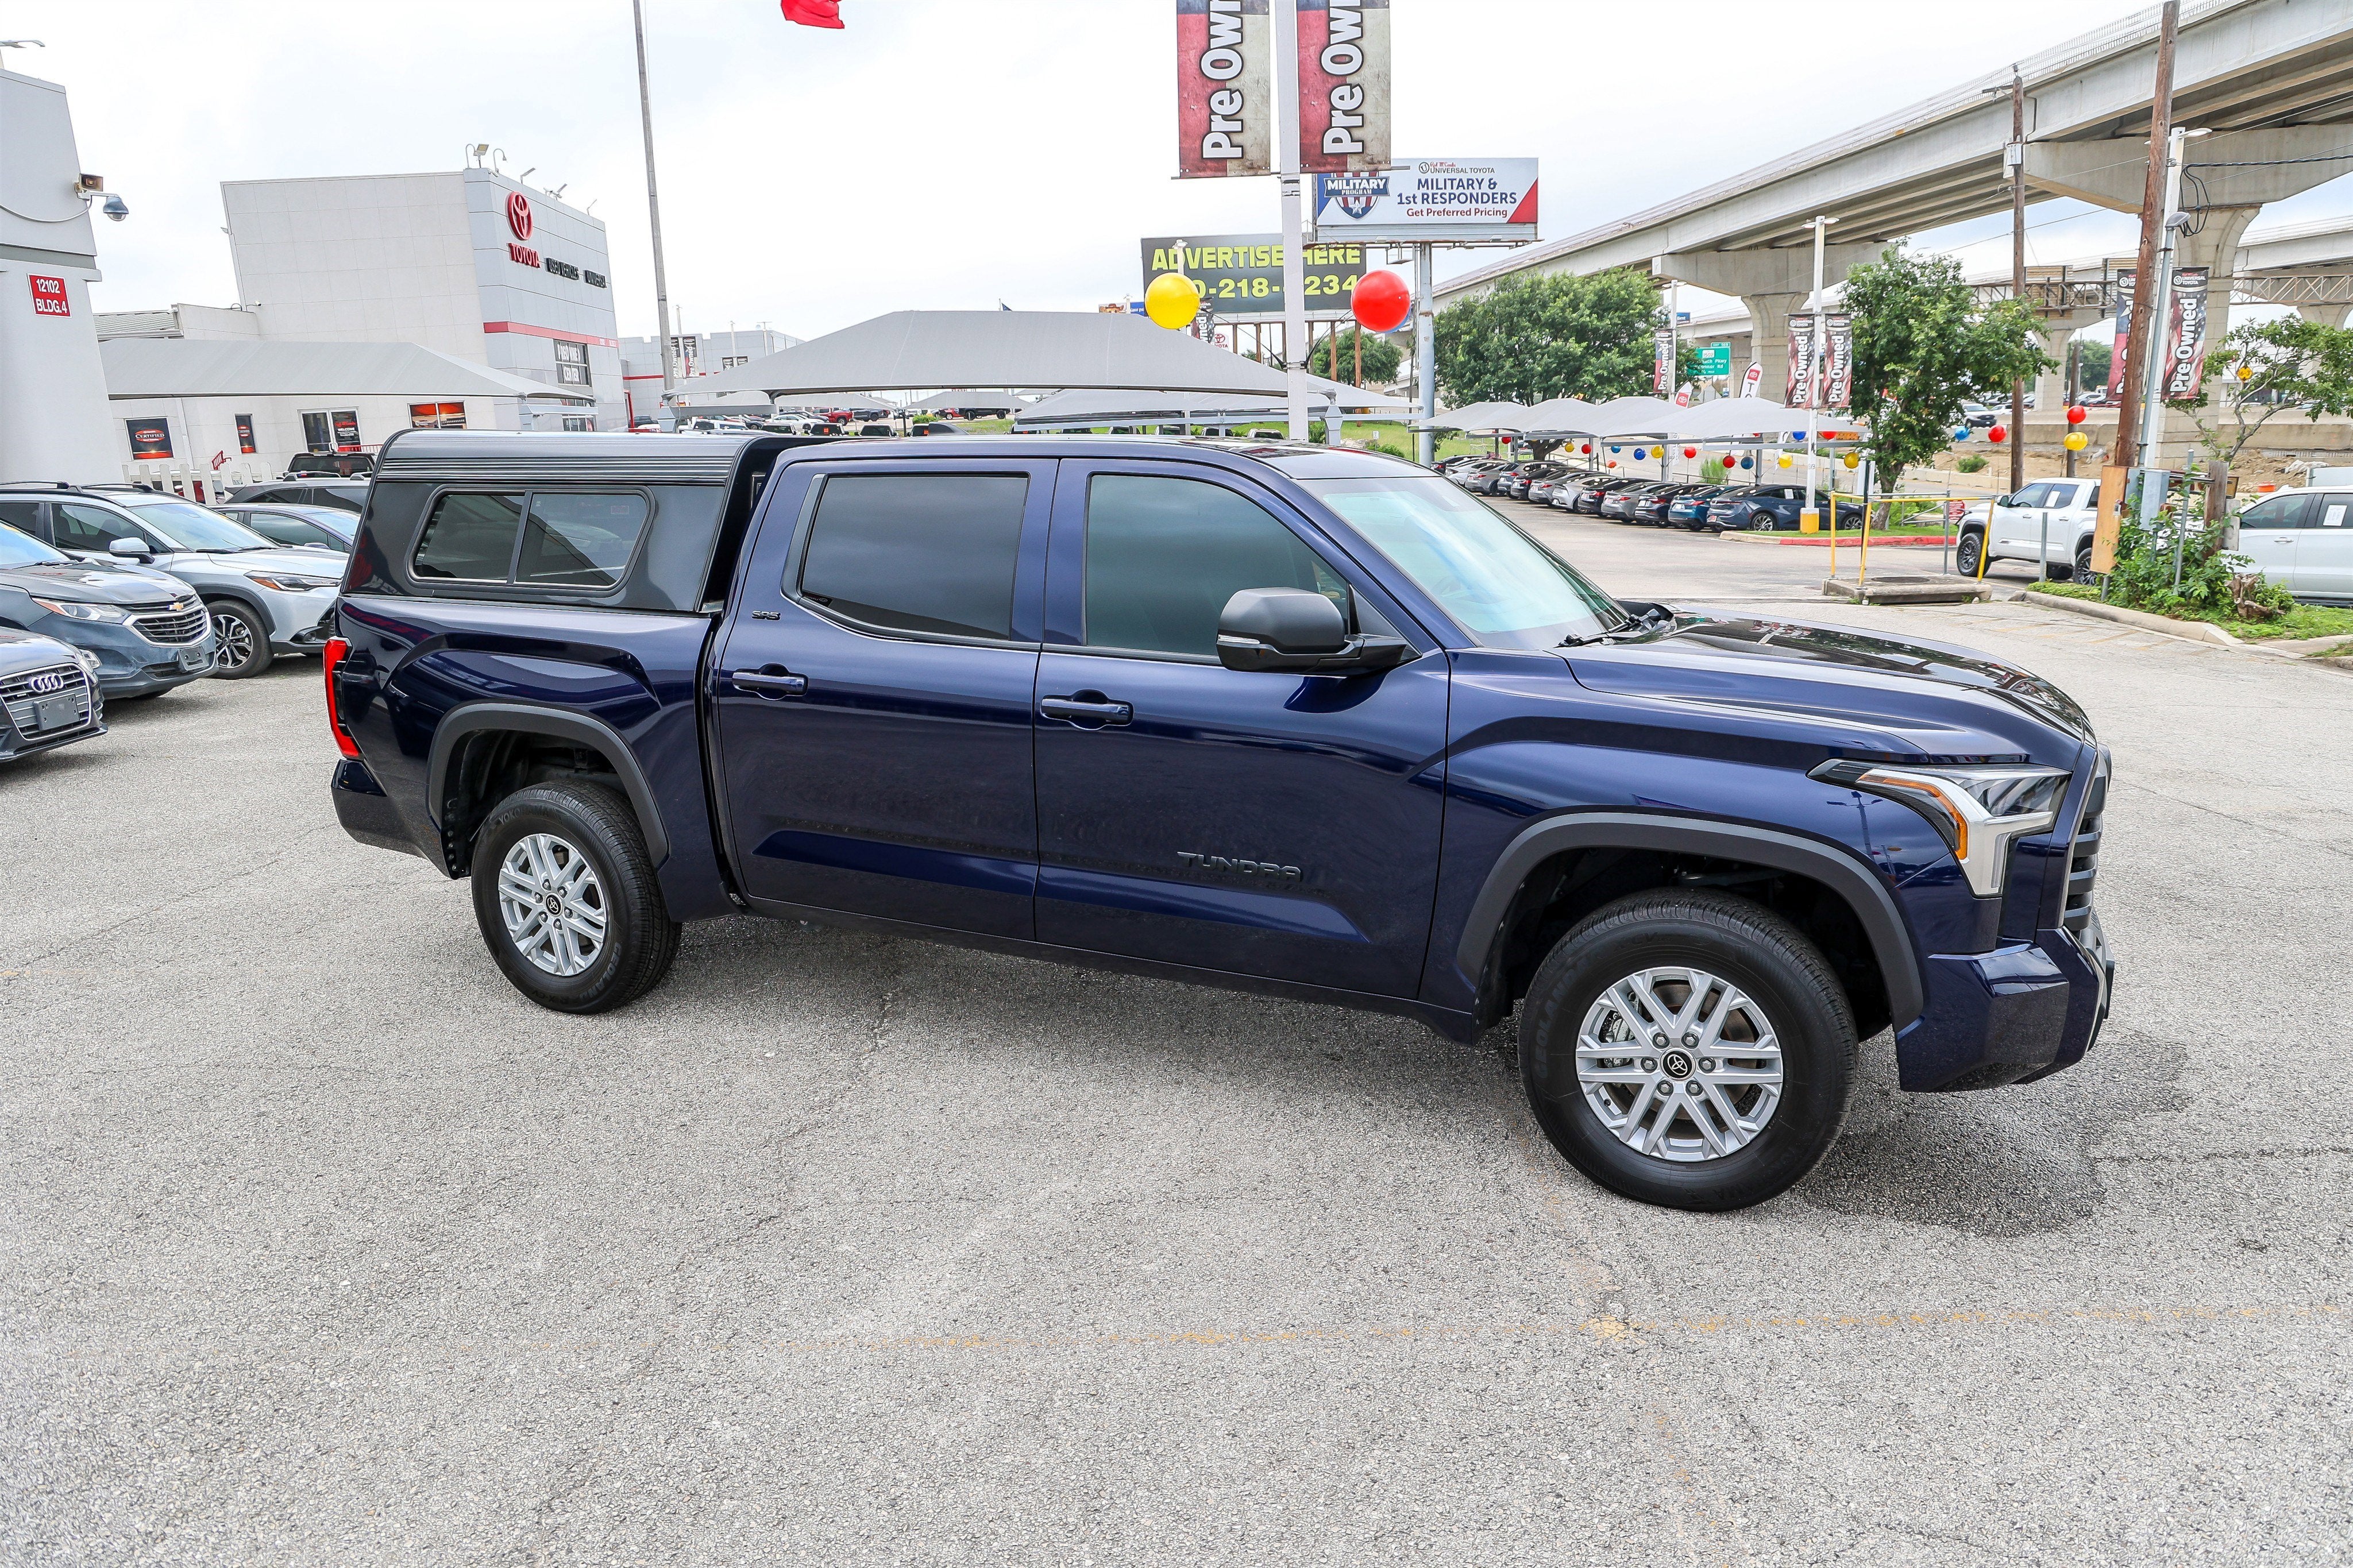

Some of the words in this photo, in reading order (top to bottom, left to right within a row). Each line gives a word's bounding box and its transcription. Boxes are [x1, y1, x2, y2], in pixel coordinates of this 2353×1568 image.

[1320, 0, 1364, 76] Ow
[1202, 88, 1243, 159] Pre
[1322, 83, 1364, 154] Pre
[1327, 179, 1386, 191] MILITARY
[1417, 177, 1484, 191] MILITARY
[1487, 177, 1498, 191] &
[1397, 193, 1418, 205] 1st
[1421, 192, 1517, 204] RESPONDERS
[1407, 208, 1424, 217] Get
[1426, 207, 1472, 217] Preferred
[1474, 207, 1508, 218] Pricing
[508, 242, 541, 268] TOYOTA
[36, 279, 60, 293] 12102
[2175, 298, 2198, 360] Owned
[1659, 343, 1669, 374] Owned
[1795, 335, 1809, 380] Owned
[1830, 335, 1845, 380] Owned
[1657, 376, 1668, 390] Pre
[2170, 362, 2192, 392] Pre
[1792, 381, 1807, 403] Pre
[1828, 381, 1843, 403] Pre
[751, 610, 781, 621] SR5
[1176, 851, 1304, 882] TUNDRA
